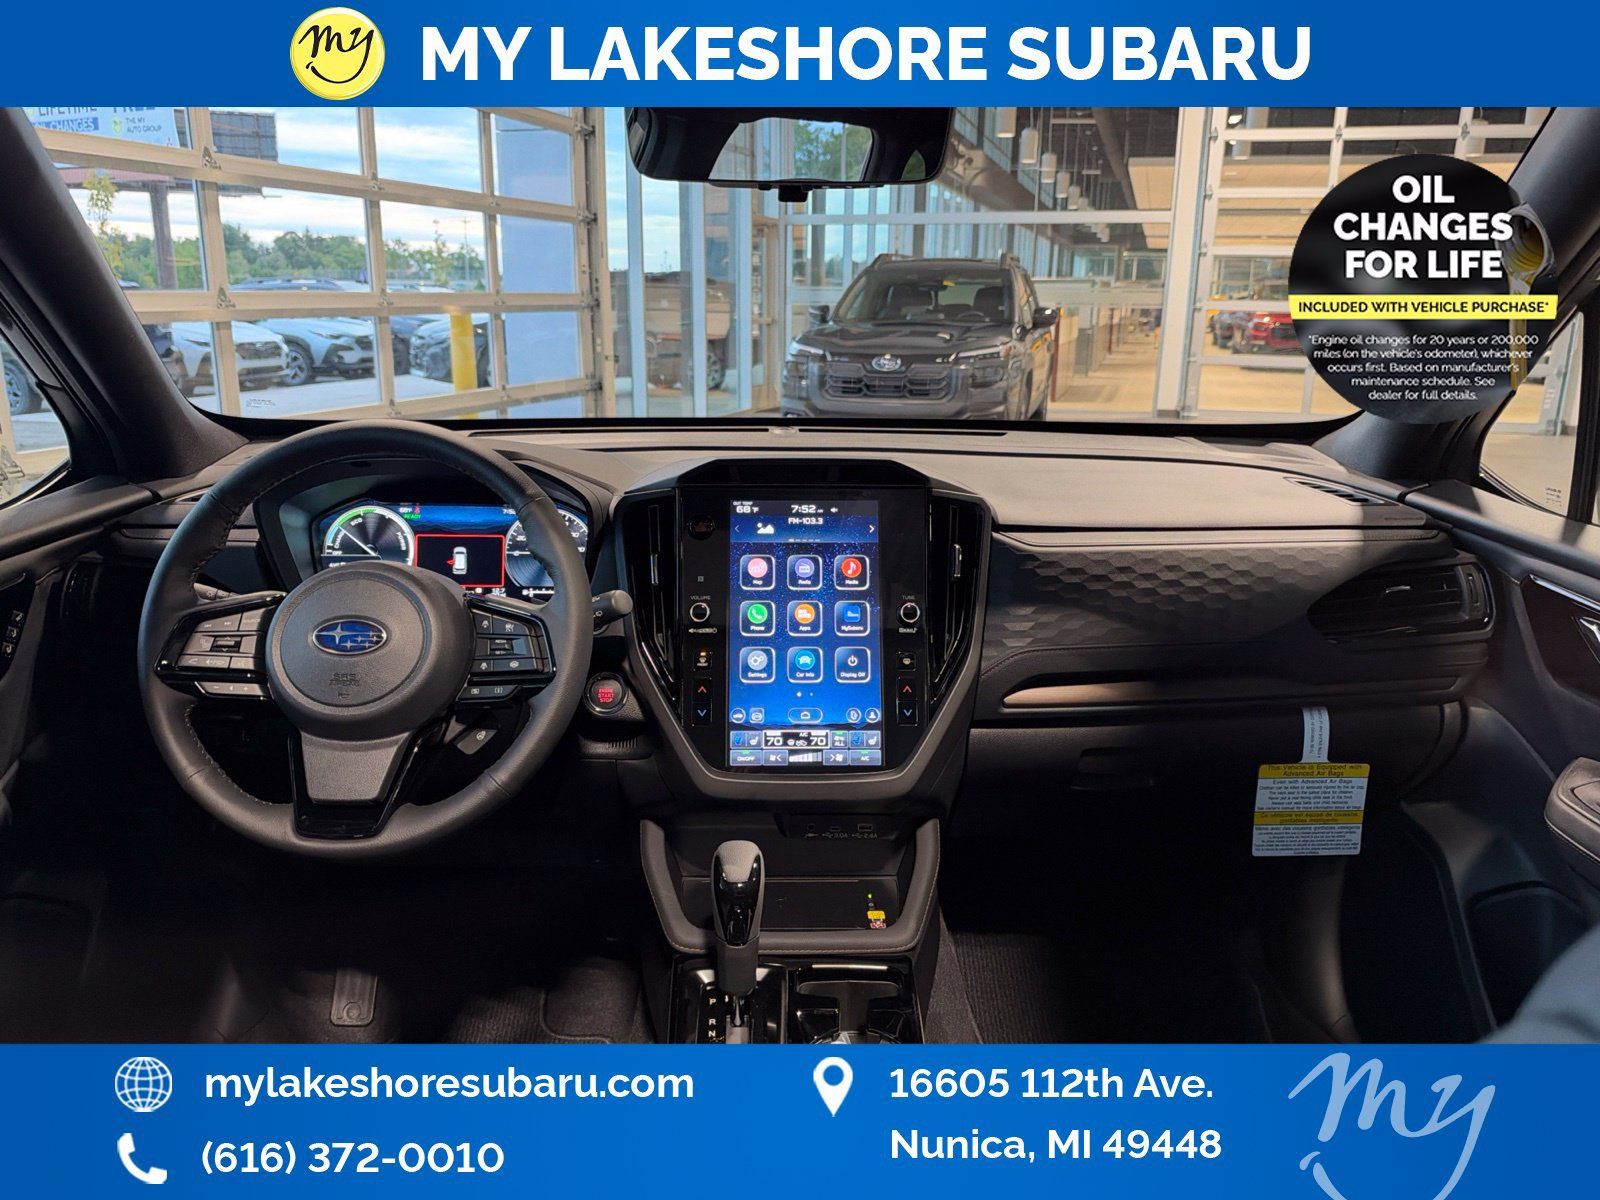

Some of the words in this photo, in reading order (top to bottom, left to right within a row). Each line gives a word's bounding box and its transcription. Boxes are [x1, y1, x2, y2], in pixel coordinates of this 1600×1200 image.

[791, 505, 816, 513] 7:52
[766, 737, 783, 745] 70
[810, 737, 826, 745] 70
[709, 997, 717, 1005] P
[708, 1018, 716, 1026] R
